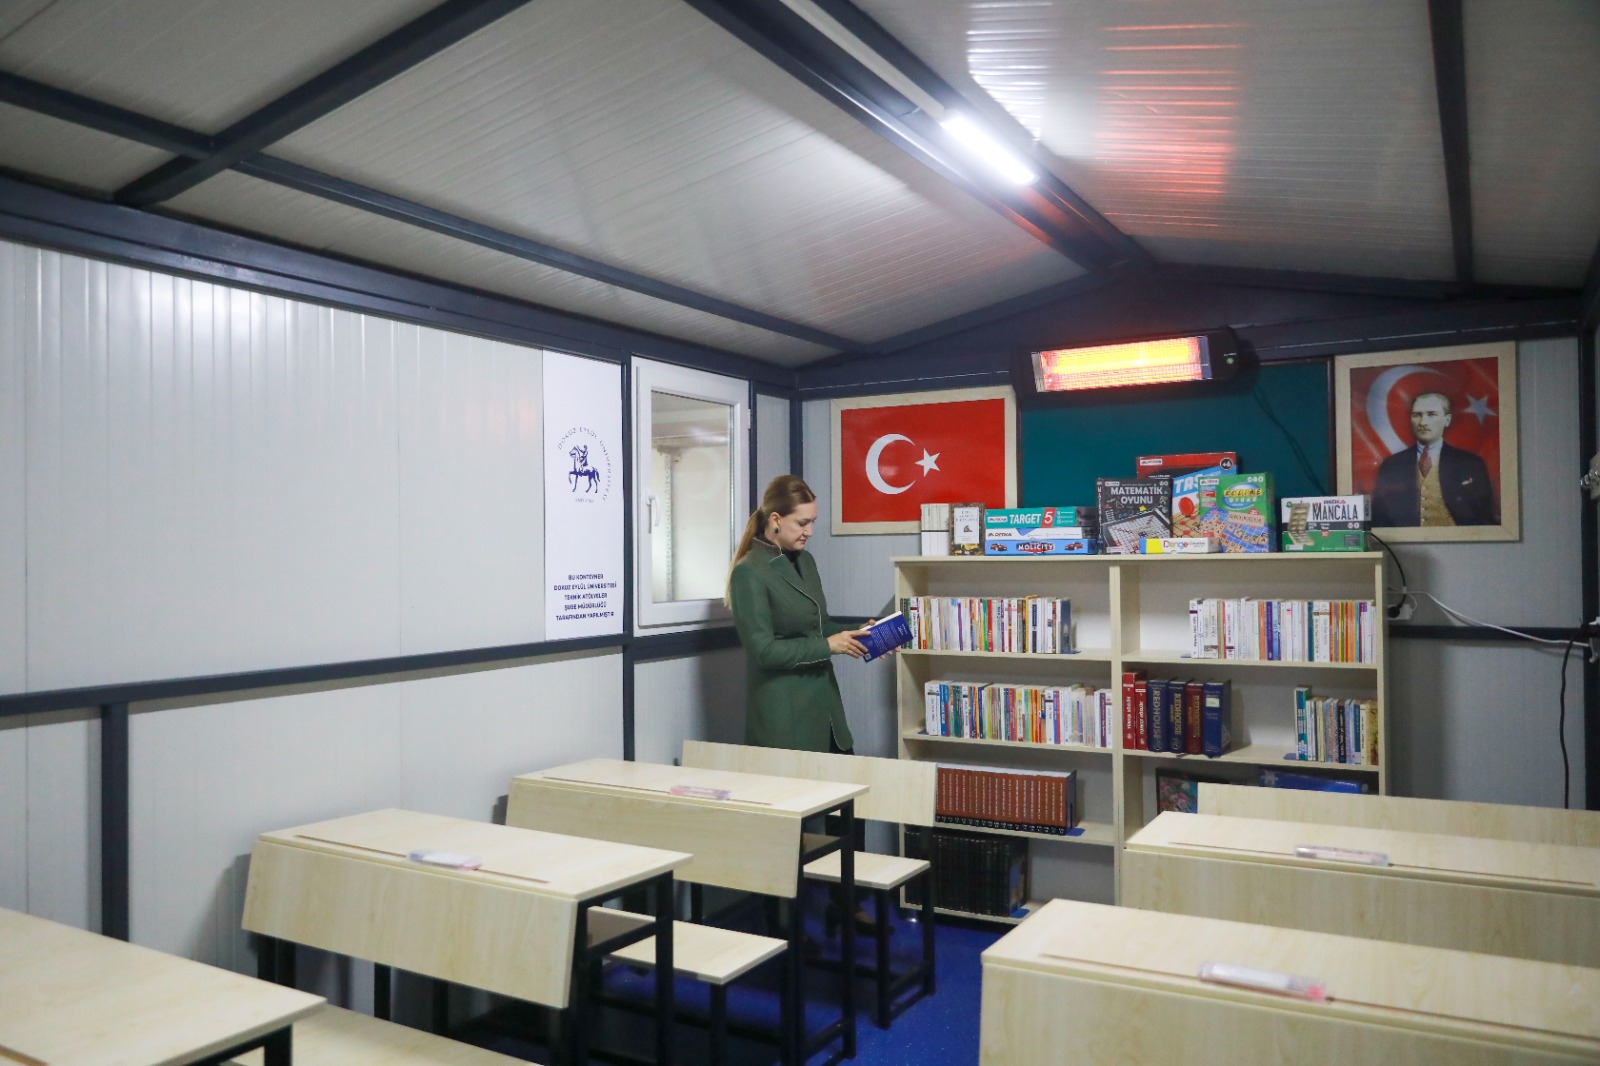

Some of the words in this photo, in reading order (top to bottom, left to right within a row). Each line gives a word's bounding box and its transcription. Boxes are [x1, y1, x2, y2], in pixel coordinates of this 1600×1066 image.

[1110, 484, 1163, 495] MATEMATİK
[1120, 496, 1153, 505] OYUNU
[1009, 513, 1042, 525] TARGET
[1044, 511, 1053, 524] 5
[1312, 502, 1359, 521] MANCALA
[1152, 689, 1161, 740] REDHOUSE
[1174, 693, 1182, 735] REDHOUSE
